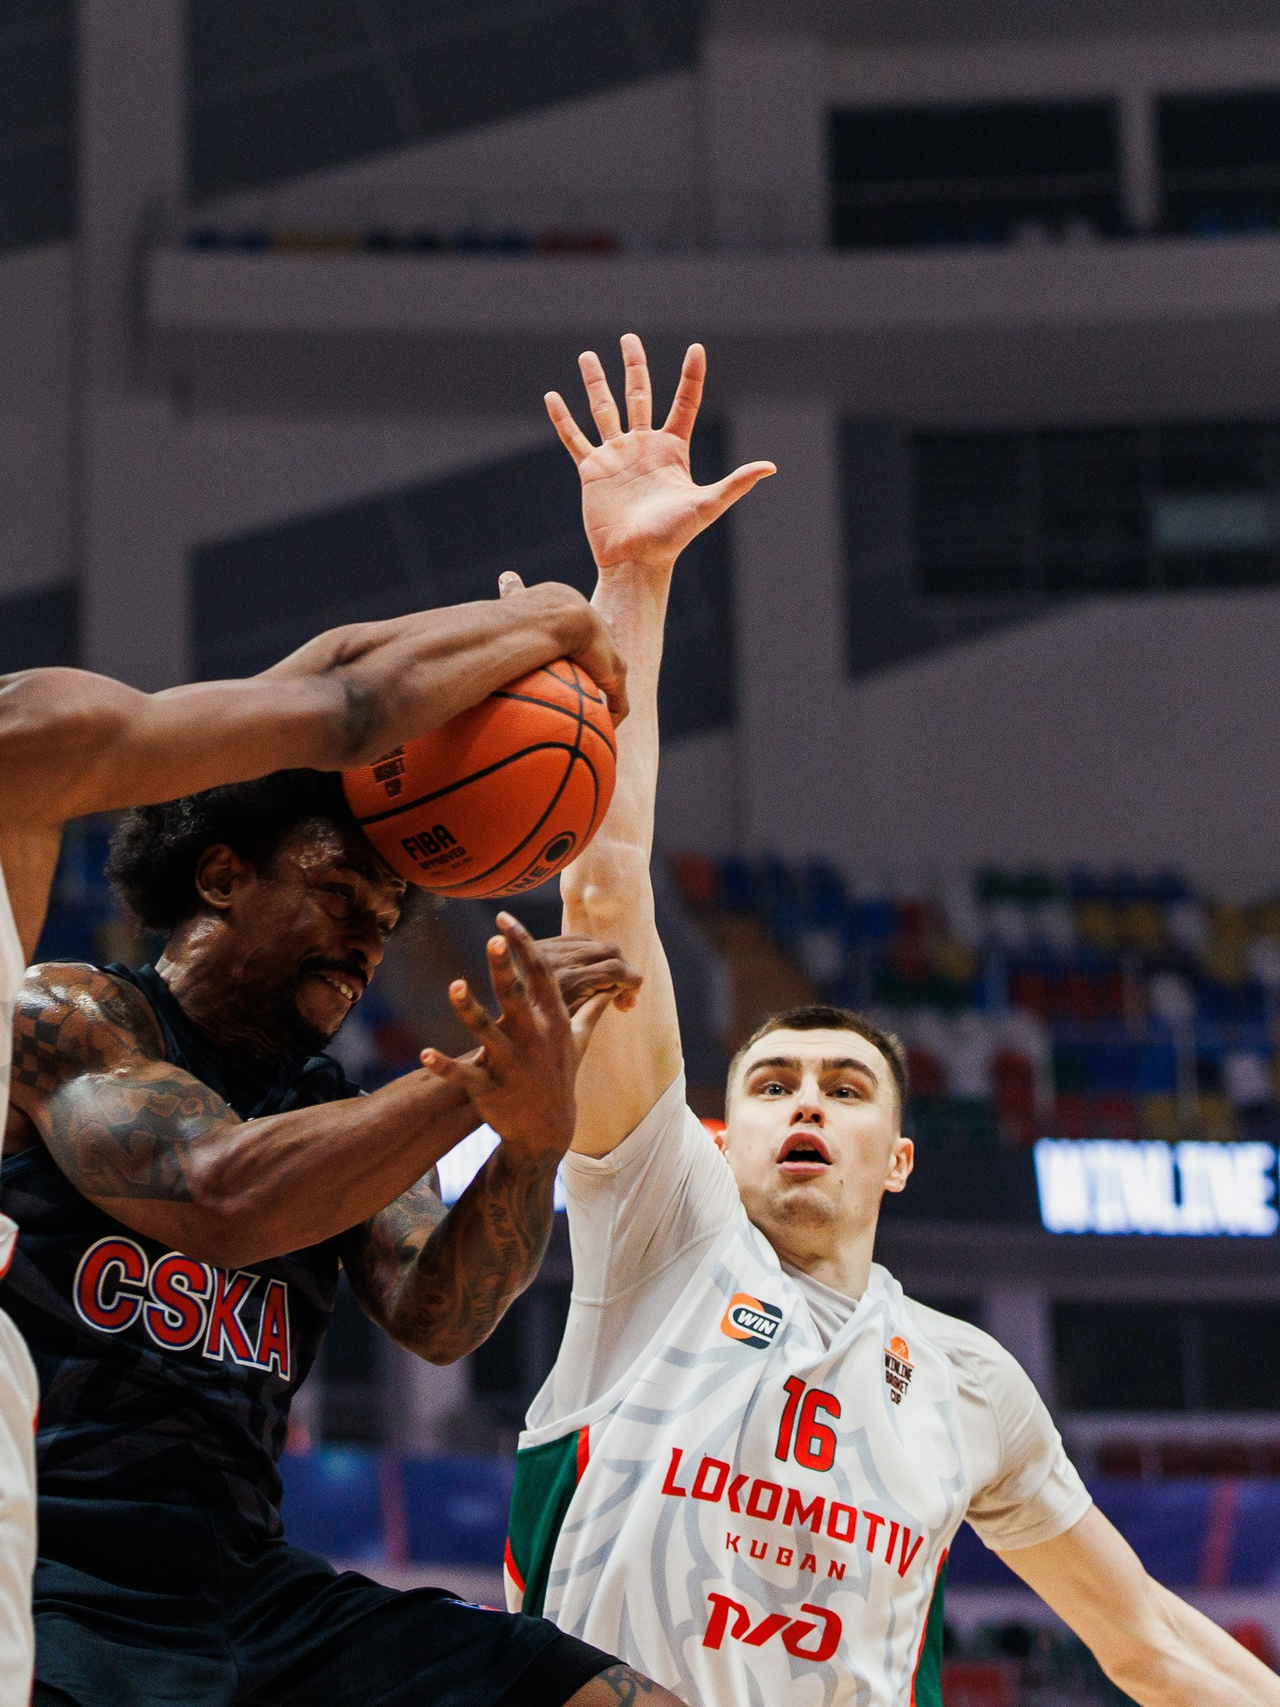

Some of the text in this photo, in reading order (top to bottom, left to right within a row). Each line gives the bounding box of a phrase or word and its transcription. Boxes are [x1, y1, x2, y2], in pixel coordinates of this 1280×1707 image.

[400, 824, 458, 861] FIBA
[1033, 1137, 1279, 1238] WINLINE
[73, 1235, 291, 1382] CSKA
[736, 1306, 778, 1336] WIN
[774, 1374, 842, 1473] 16
[661, 1447, 924, 1579] LOKOMOTIV
[725, 1532, 848, 1582] KUBAN
